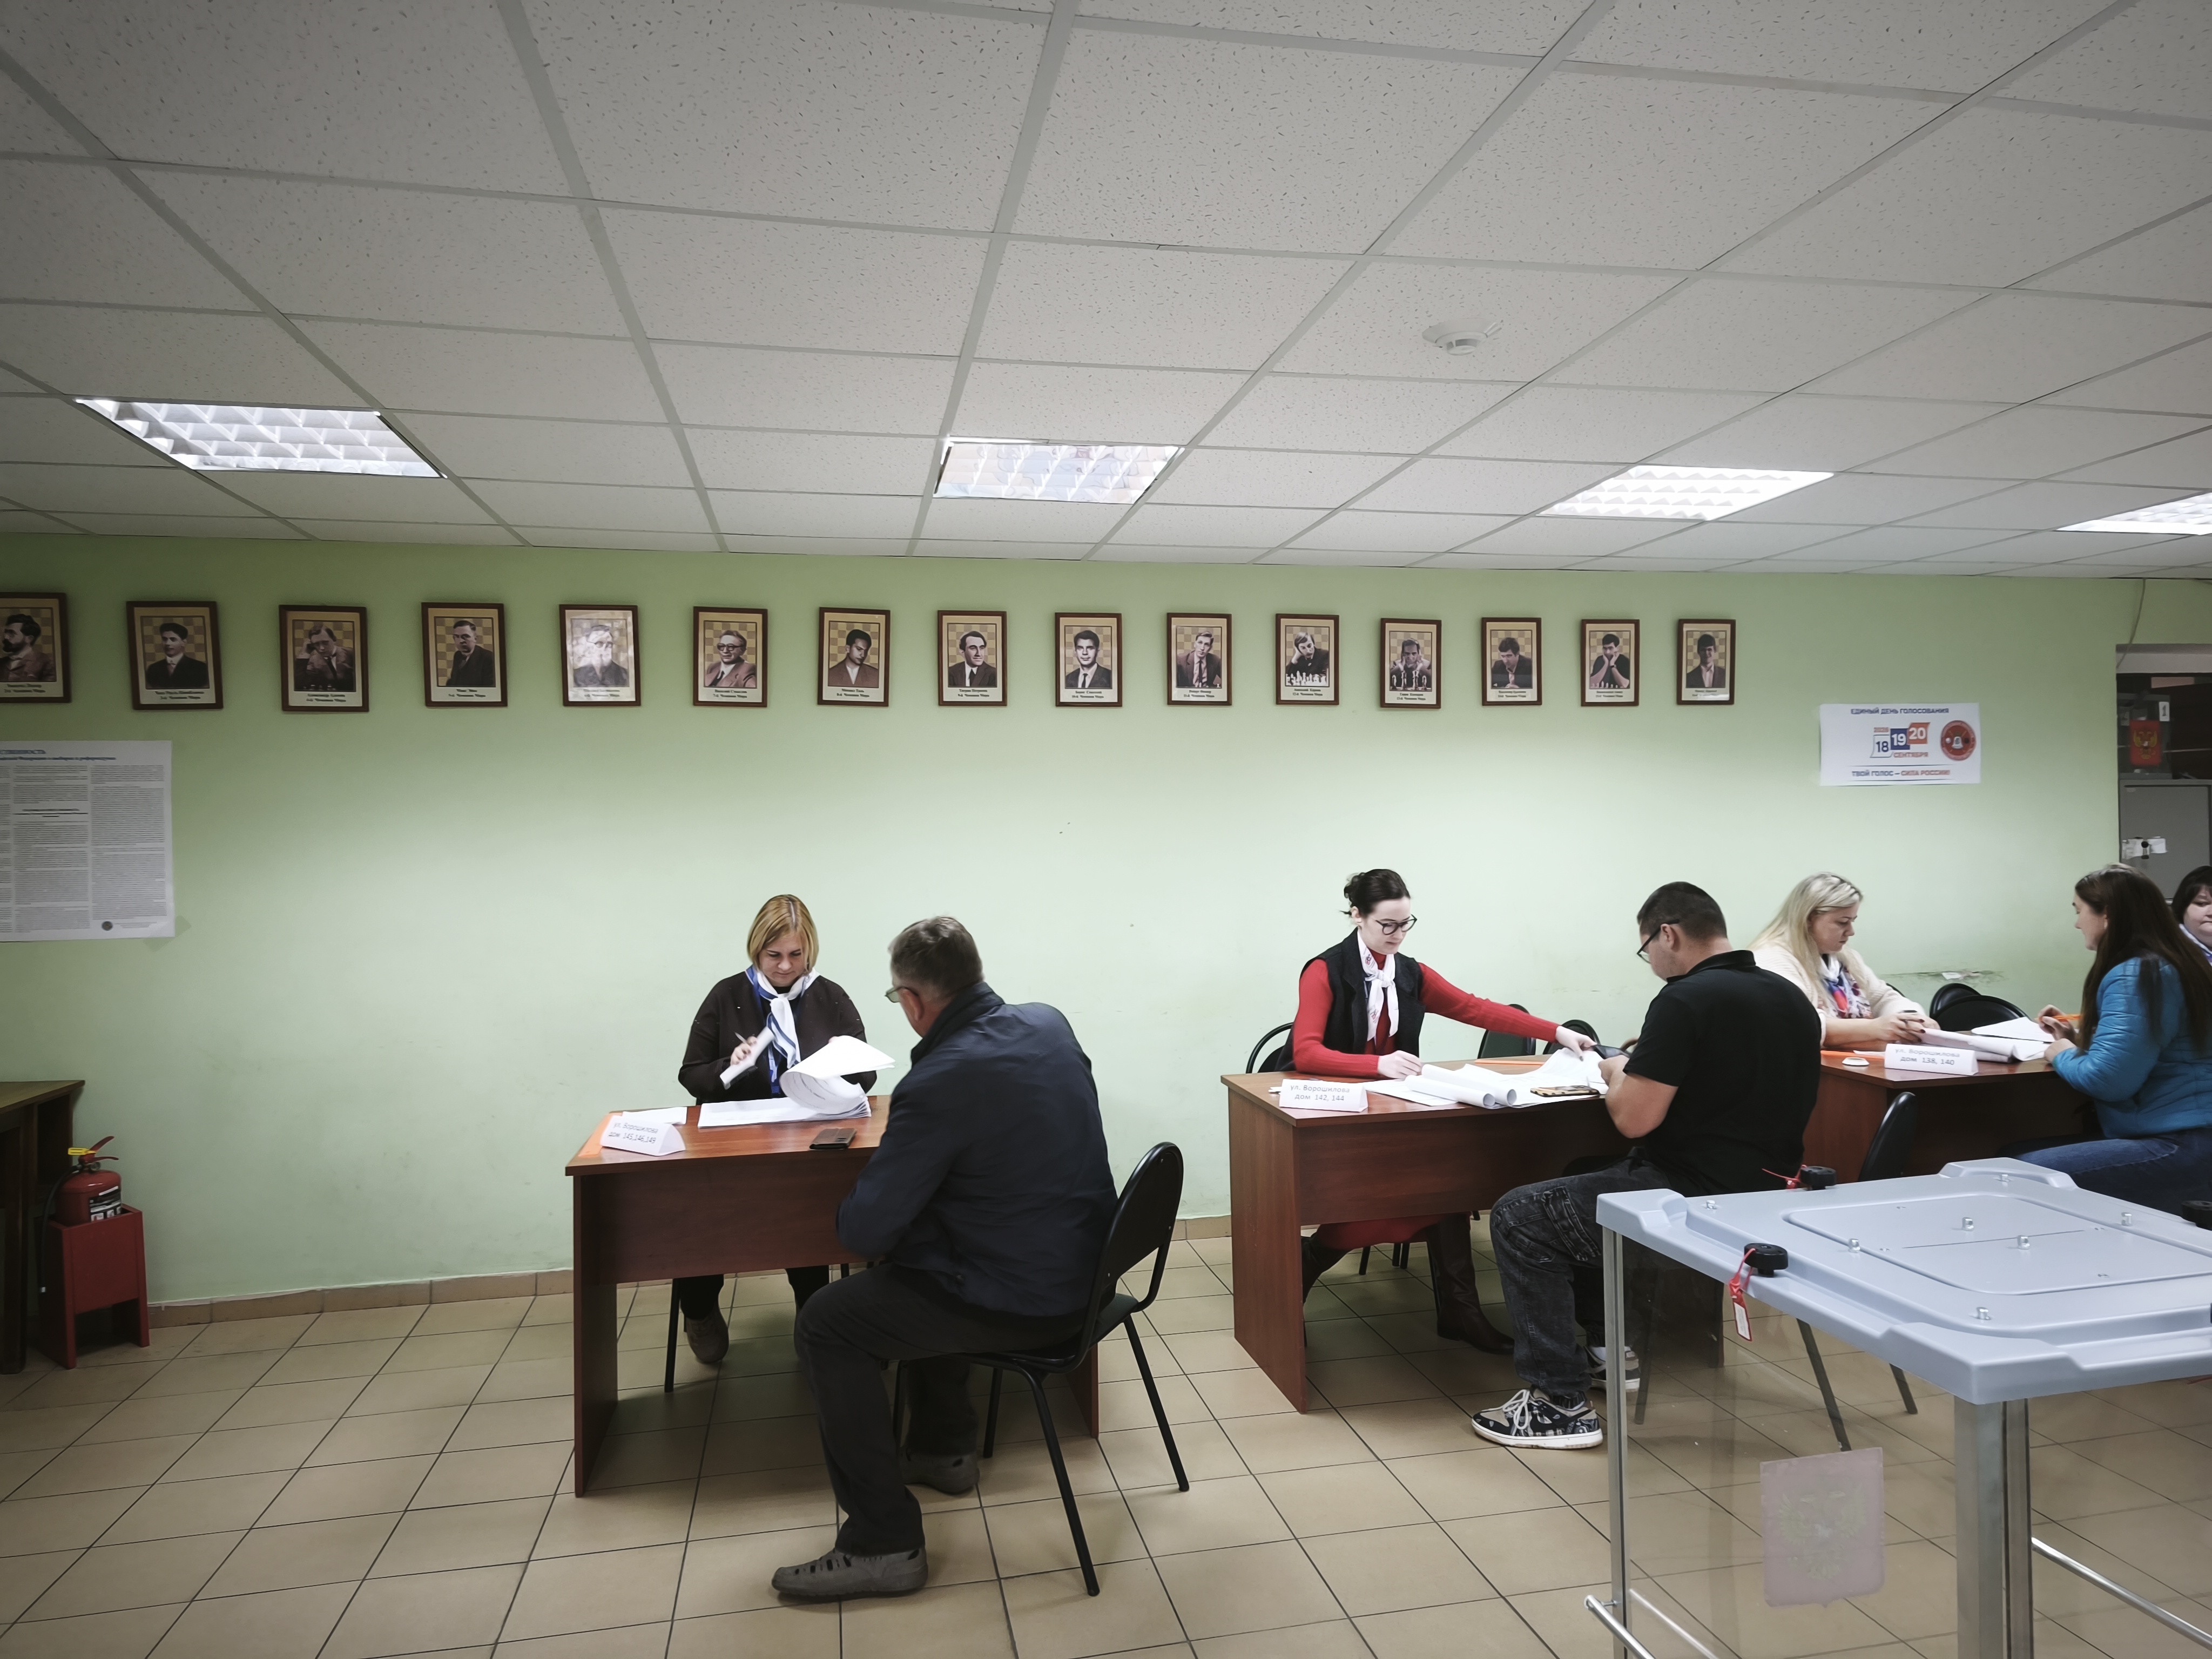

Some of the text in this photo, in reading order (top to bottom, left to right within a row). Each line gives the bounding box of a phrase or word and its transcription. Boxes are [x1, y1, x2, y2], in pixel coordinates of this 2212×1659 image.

[1876, 727, 1926, 753] 18 19 20
[1908, 1049, 1960, 1057] Ворошилова
[1303, 1084, 1350, 1093] Ворошилова
[623, 1122, 658, 1134] Ворошилова
